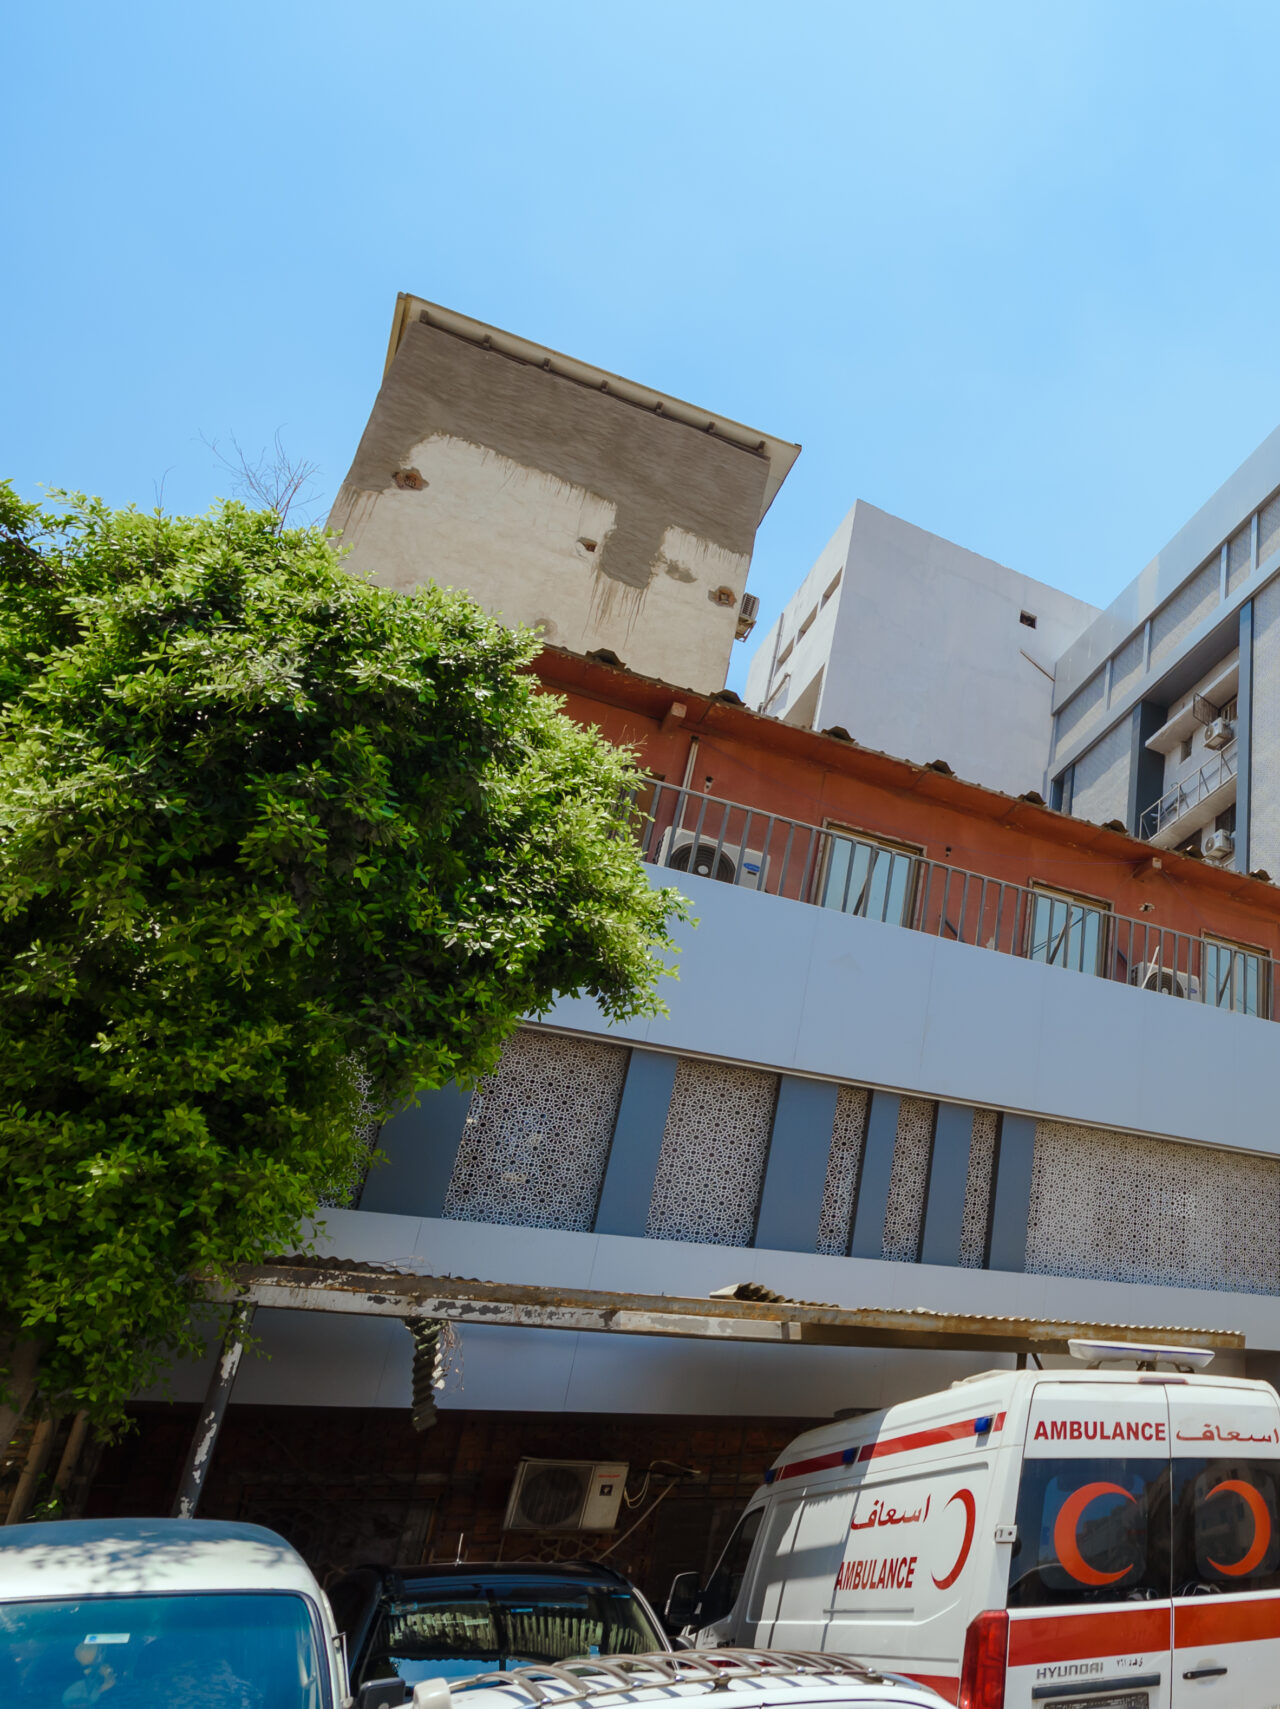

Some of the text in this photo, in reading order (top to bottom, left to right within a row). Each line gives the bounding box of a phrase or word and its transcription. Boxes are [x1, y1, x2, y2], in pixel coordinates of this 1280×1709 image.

[1033, 1420, 1166, 1441] AMBULANCE
[1176, 1423, 1280, 1444] اسعاف
[850, 1493, 931, 1530] اسعاف
[833, 1556, 918, 1591] AMBULANCE
[1036, 1662, 1104, 1680] HYUNDAI
